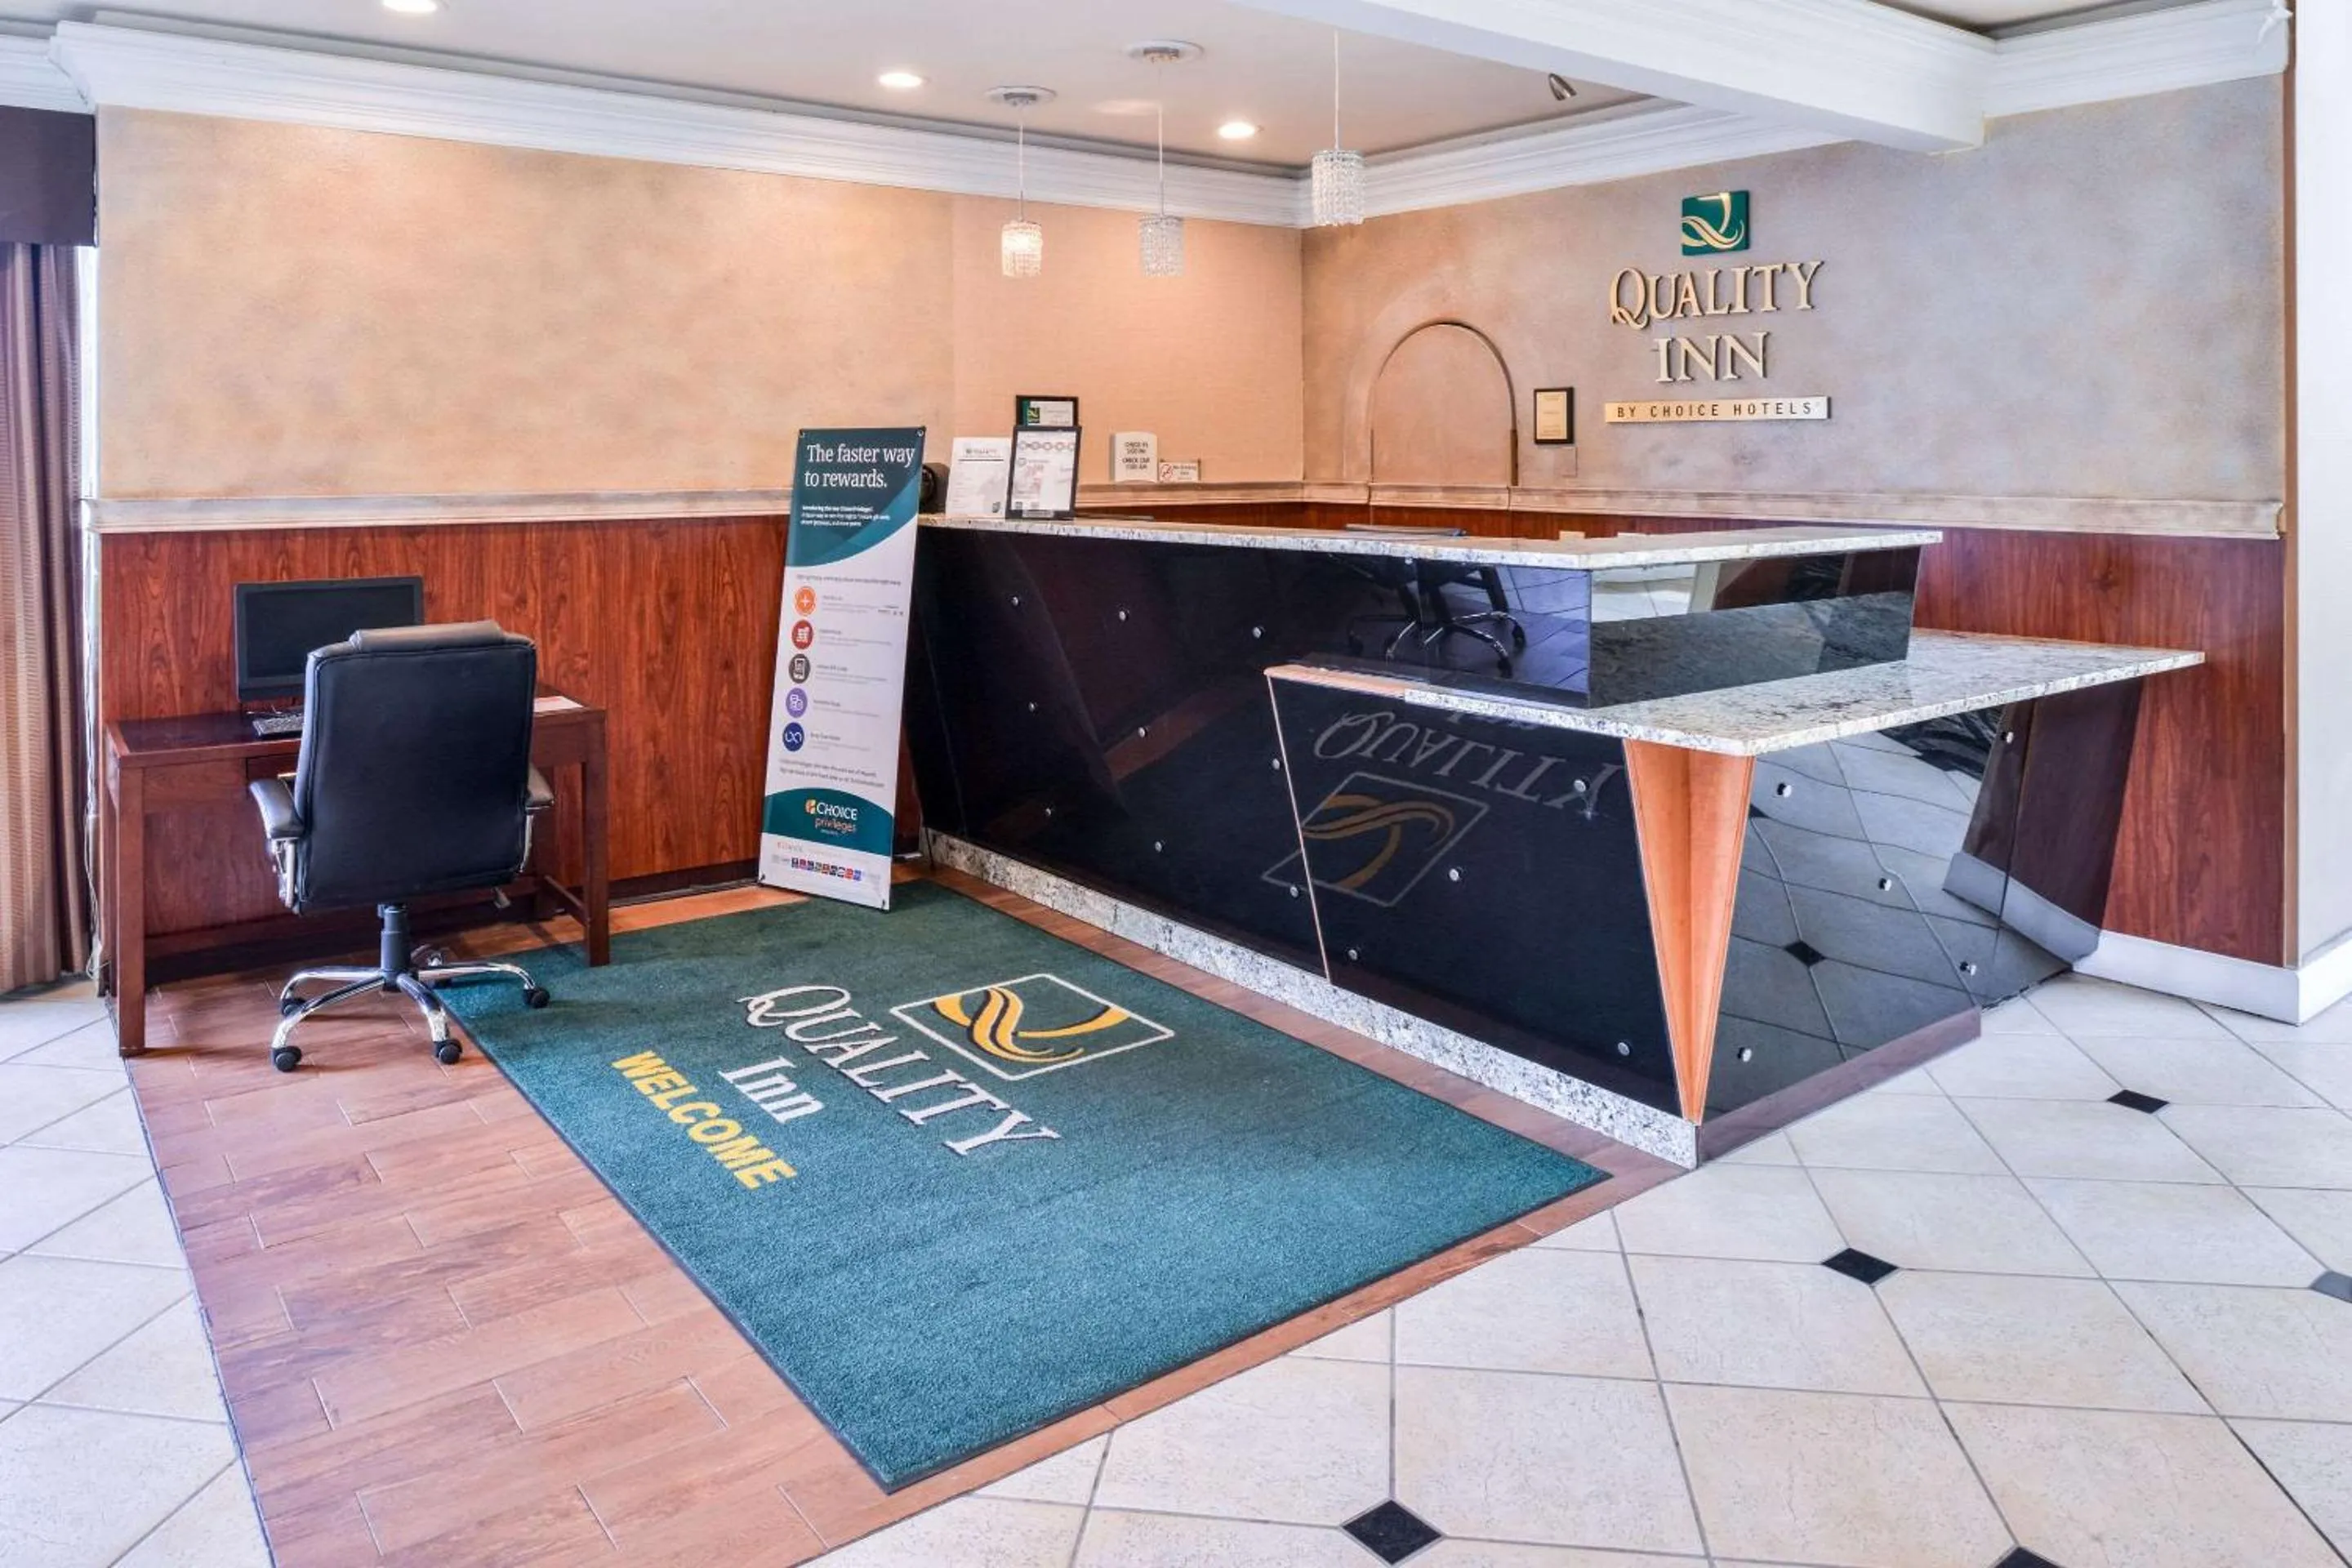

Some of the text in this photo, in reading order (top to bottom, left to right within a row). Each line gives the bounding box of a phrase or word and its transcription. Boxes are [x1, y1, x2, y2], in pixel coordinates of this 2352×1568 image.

[1609, 260, 1825, 331] QUALITY
[1652, 331, 1771, 383] INN
[1616, 401, 1812, 418] BY CHOICE HOTELS
[807, 443, 915, 468] The faster way
[804, 468, 888, 488] to rewards.
[815, 817, 857, 834] privileges
[817, 802, 858, 821] CHOICE
[737, 985, 1062, 1156] QUALITY
[717, 1055, 826, 1125] Inn
[610, 1049, 798, 1190] WELCOME
